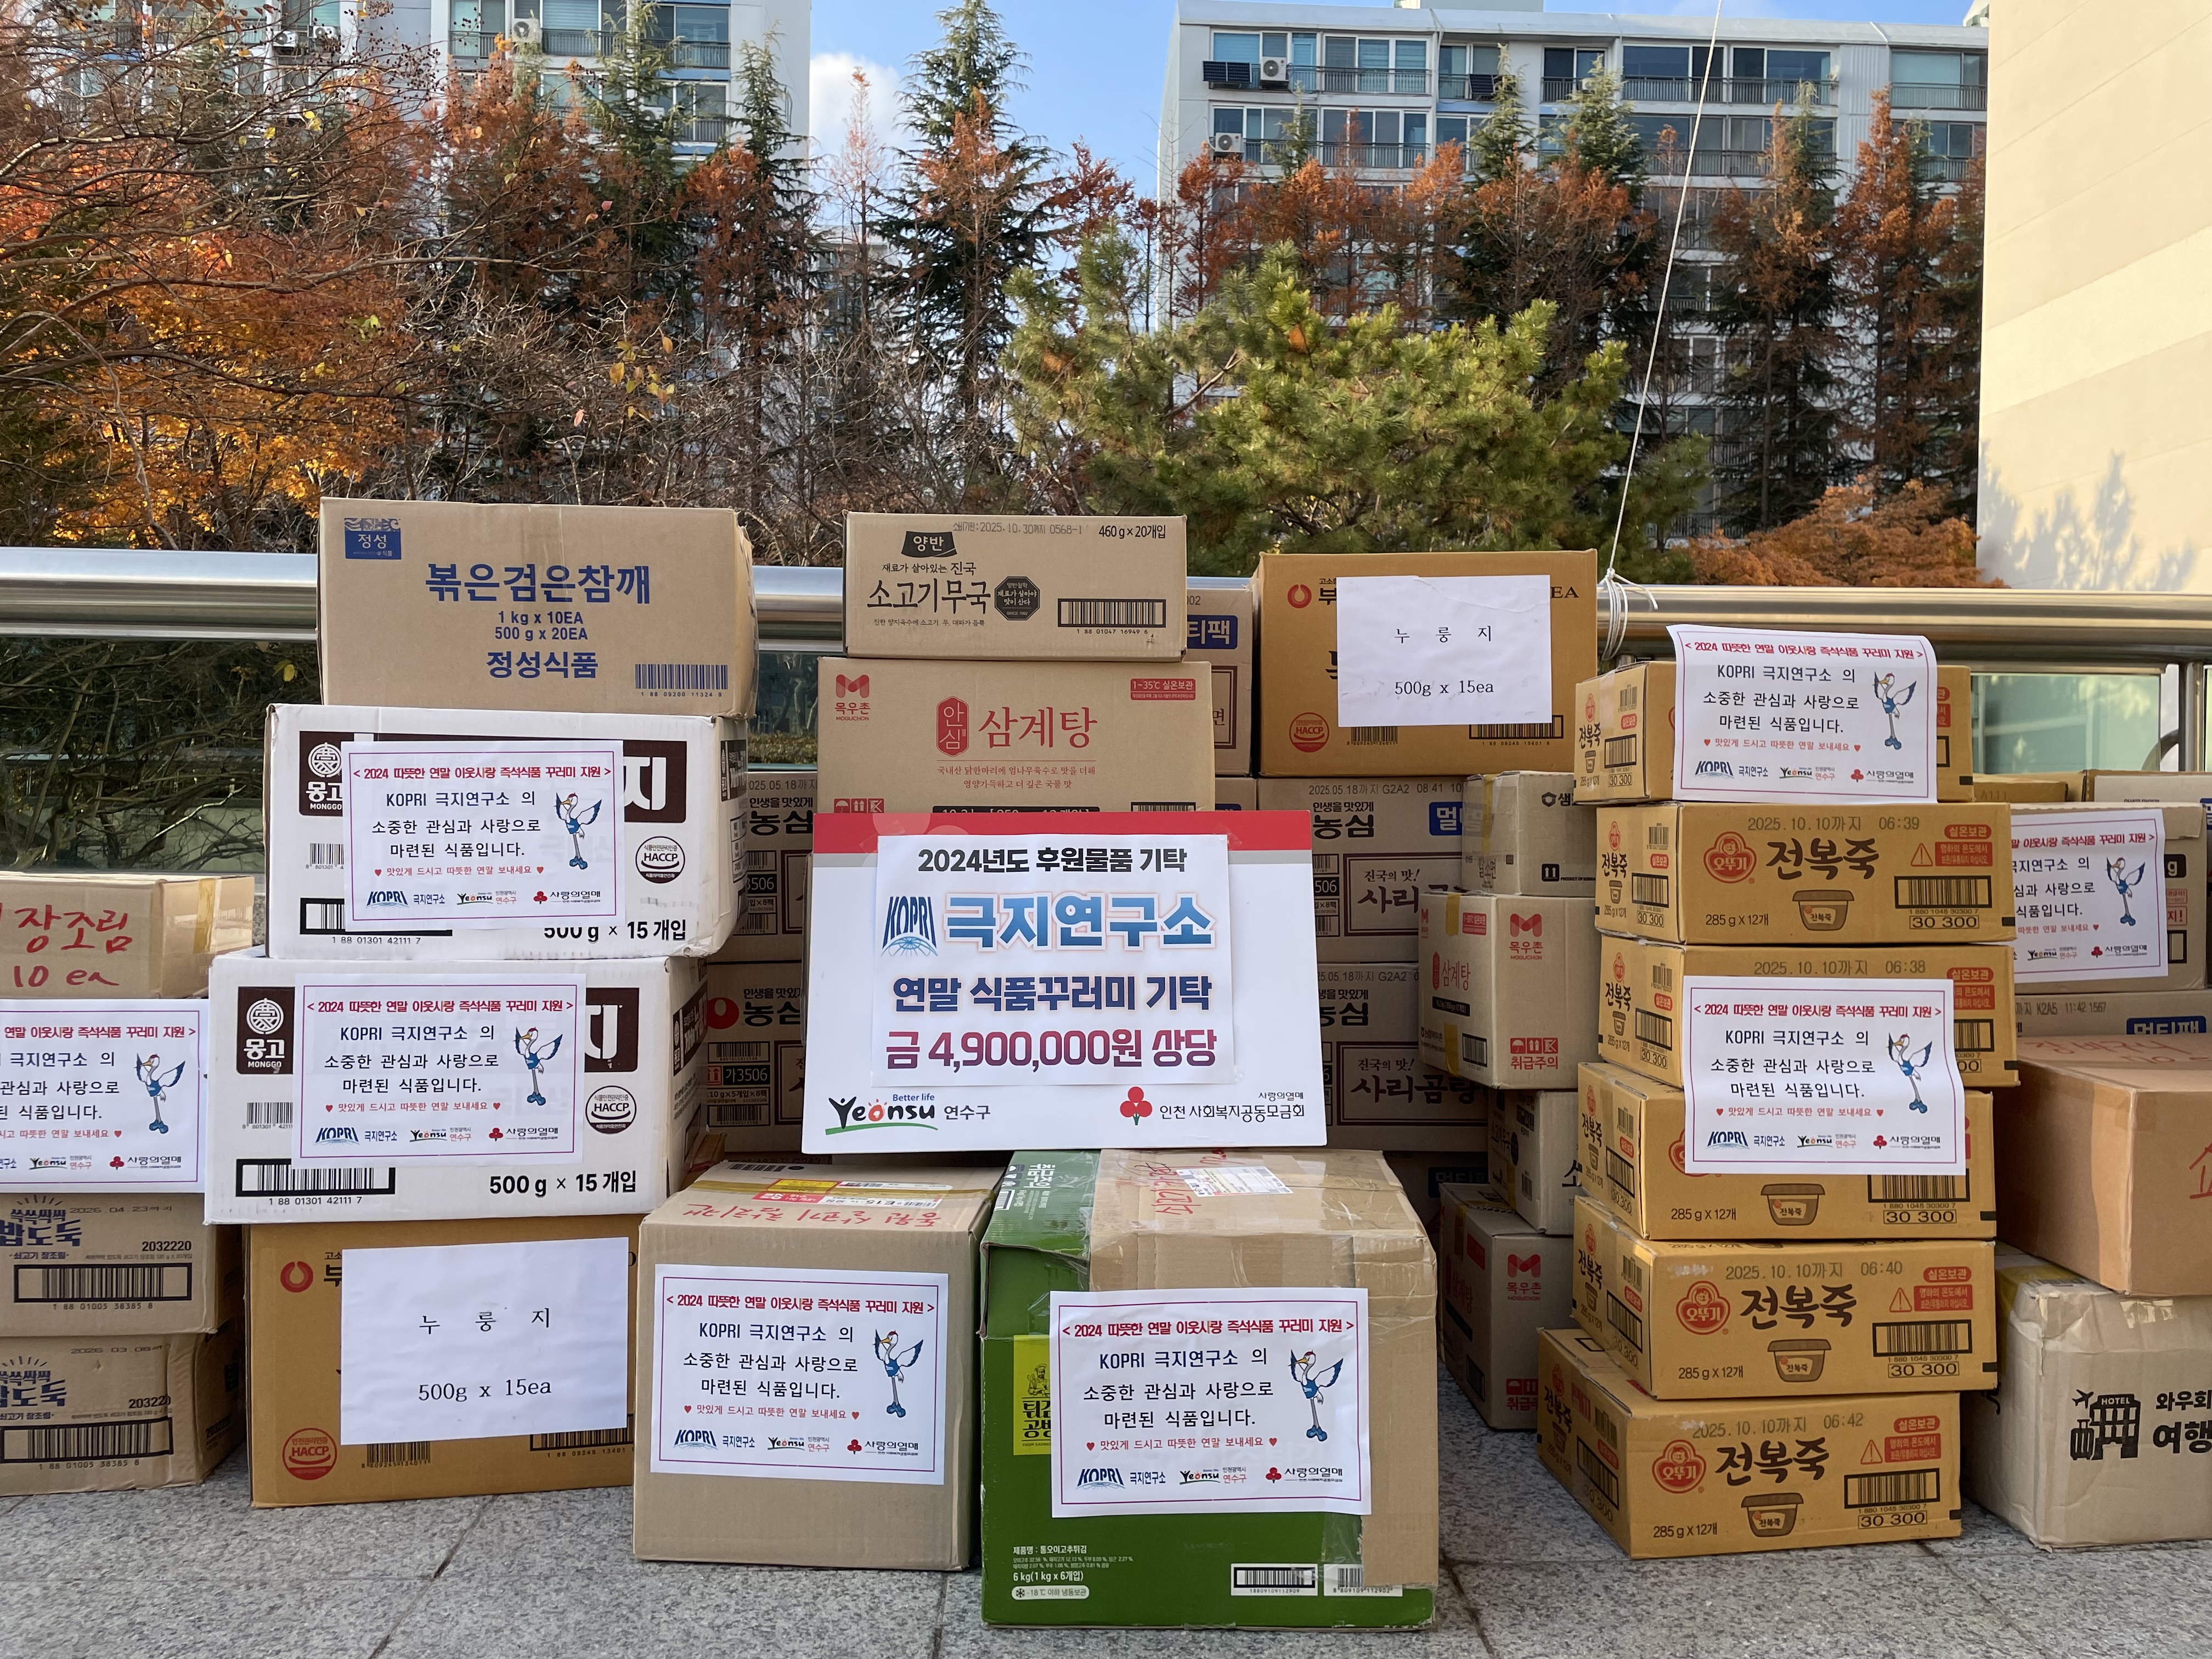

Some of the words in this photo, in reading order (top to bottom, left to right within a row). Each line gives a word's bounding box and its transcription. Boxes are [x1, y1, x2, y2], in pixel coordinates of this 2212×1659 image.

[358, 534, 386, 549] 정성
[913, 537, 944, 551] 양반
[882, 563, 909, 573] 재료가
[912, 563, 947, 573] 살아있는
[951, 562, 976, 575] 진국
[426, 564, 650, 603] 볶은검은참깨
[867, 578, 991, 614] 소고기무국
[499, 611, 504, 623] 1
[511, 611, 528, 625] kg
[534, 614, 541, 623] x
[548, 612, 583, 624] 10EA
[495, 627, 519, 639] 500
[526, 630, 533, 641] g
[539, 630, 546, 639] x
[552, 628, 588, 640] 20EA
[487, 651, 598, 678] 정성식품
[1718, 665, 1754, 678] KOPRI
[1763, 667, 1831, 681] 극지연구소
[1843, 669, 1854, 682] 의
[1163, 680, 1193, 690] 실온보관
[1395, 681, 1431, 696] 500g
[1440, 685, 1448, 693] x
[1460, 680, 1493, 693] 15ea
[835, 703, 870, 714] 목우촌
[979, 707, 1097, 748] 삼계탕
[938, 766, 962, 775] 국내산
[1061, 766, 1076, 775] 맛을
[1080, 766, 1095, 775] 더해
[964, 780, 1013, 788] 영양가득하고
[1017, 780, 1023, 788] 더
[1026, 780, 1042, 788] 깊은
[1045, 780, 1061, 788] 국물
[1064, 780, 1072, 788] 맛
[1313, 802, 1341, 812] 인생을
[1344, 802, 1374, 812] 맛있게
[373, 820, 417, 834] 소중한
[426, 820, 471, 833] 관심과
[481, 819, 540, 833] 사랑으로
[1313, 815, 1374, 839] 농심
[1879, 817, 1919, 830] 06:39
[391, 844, 434, 858] 마련된
[445, 843, 524, 857] 식품입니다.
[918, 849, 1029, 872] 2024년도
[1036, 848, 1132, 872] 후원물품
[1140, 849, 1187, 872] 기탁
[1713, 857, 1747, 873] 오뚜기
[1766, 838, 1879, 880] 전복죽
[1364, 870, 1396, 882] 진국의
[1401, 869, 1420, 882] 맛!
[2016, 903, 2082, 918] 식품입니다.
[882, 895, 937, 951] KOPRI
[945, 894, 1214, 949] 극지연구소
[1706, 915, 1725, 925] 285
[1912, 917, 1935, 928] 30
[1942, 917, 1977, 928] 300
[14, 966, 48, 987] 10
[66, 970, 119, 986] ea
[894, 978, 961, 1012] 연말
[970, 977, 1135, 1011] 식품꾸러미
[1147, 976, 1212, 1010] 기탁
[244, 1039, 285, 1059] 몽고
[887, 1032, 919, 1069] 금
[928, 1029, 1142, 1073] 4,900,000원
[1152, 1030, 1217, 1066] 상당
[10, 1053, 87, 1066] 극지연구소
[100, 1052, 114, 1066] 의
[248, 1061, 281, 1070] MONGGO
[1511, 1056, 1558, 1070] 취급주의
[726, 1068, 768, 1083] 가3506
[1259, 1092, 1304, 1102] 사랑의열매
[595, 1103, 629, 1111] HACCP
[828, 1098, 934, 1121] Yeonsu
[944, 1105, 990, 1120] 연수구
[1160, 1106, 1185, 1119] 인천
[1189, 1104, 1304, 1122] 사회복지공동모금회
[1729, 1108, 1753, 1116] 맛있게
[1758, 1108, 1782, 1116] 드시고
[1817, 1108, 1833, 1116] 연말
[1838, 1108, 1871, 1116] 보내세요
[365, 1131, 397, 1141] 극지연구소
[490, 1176, 529, 1194] 500
[535, 1180, 546, 1197] g
[576, 1174, 597, 1192] 15
[603, 1171, 635, 1193] 개입
[142, 1241, 191, 1251] 2032220
[1861, 1261, 1903, 1276] 06:40
[1740, 1284, 1857, 1329] 전복죽
[700, 1323, 740, 1338] KOPRI
[750, 1325, 826, 1341] 극지연구소
[839, 1327, 853, 1342] 의
[1075, 1325, 1102, 1336] 2024
[1108, 1323, 1143, 1336] 따뜻한
[1148, 1322, 1171, 1335] 연말
[1177, 1321, 1222, 1334] 이웃사랑
[1228, 1320, 1273, 1333] 즉석식품
[1279, 1319, 1313, 1333] 꾸러미
[1319, 1319, 1342, 1333] 지원
[419, 1384, 467, 1402] 500g
[479, 1386, 490, 1397] x
[506, 1379, 551, 1395] 15ea
[292, 1446, 329, 1457] HACCP
[1716, 1437, 1829, 1486] 전복죽
[1013, 1546, 1033, 1555] 제품명
[1041, 1545, 1086, 1554] 통오이고추튀김
[1013, 1572, 1018, 1581] 6
[1041, 1571, 1051, 1582] kg
